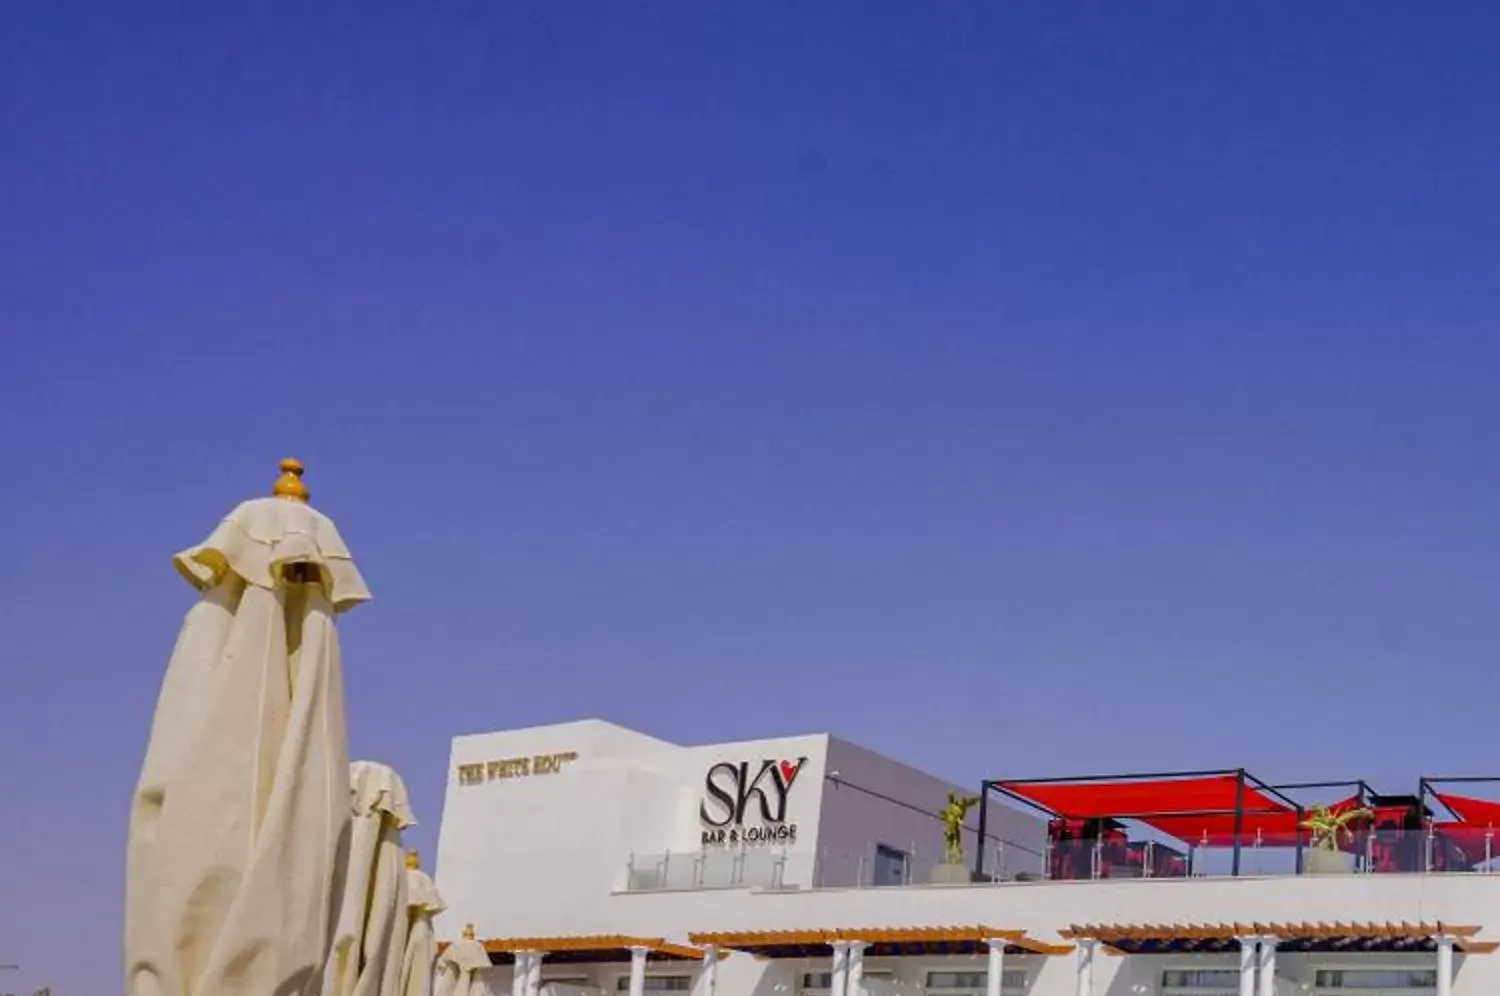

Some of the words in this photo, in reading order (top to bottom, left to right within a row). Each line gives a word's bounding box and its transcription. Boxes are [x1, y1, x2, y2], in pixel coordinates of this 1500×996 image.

[459, 763, 484, 786] THE
[700, 757, 808, 827] SKY
[701, 829, 727, 844] BAR
[729, 828, 739, 842] &
[741, 823, 797, 842] LOUNGE
